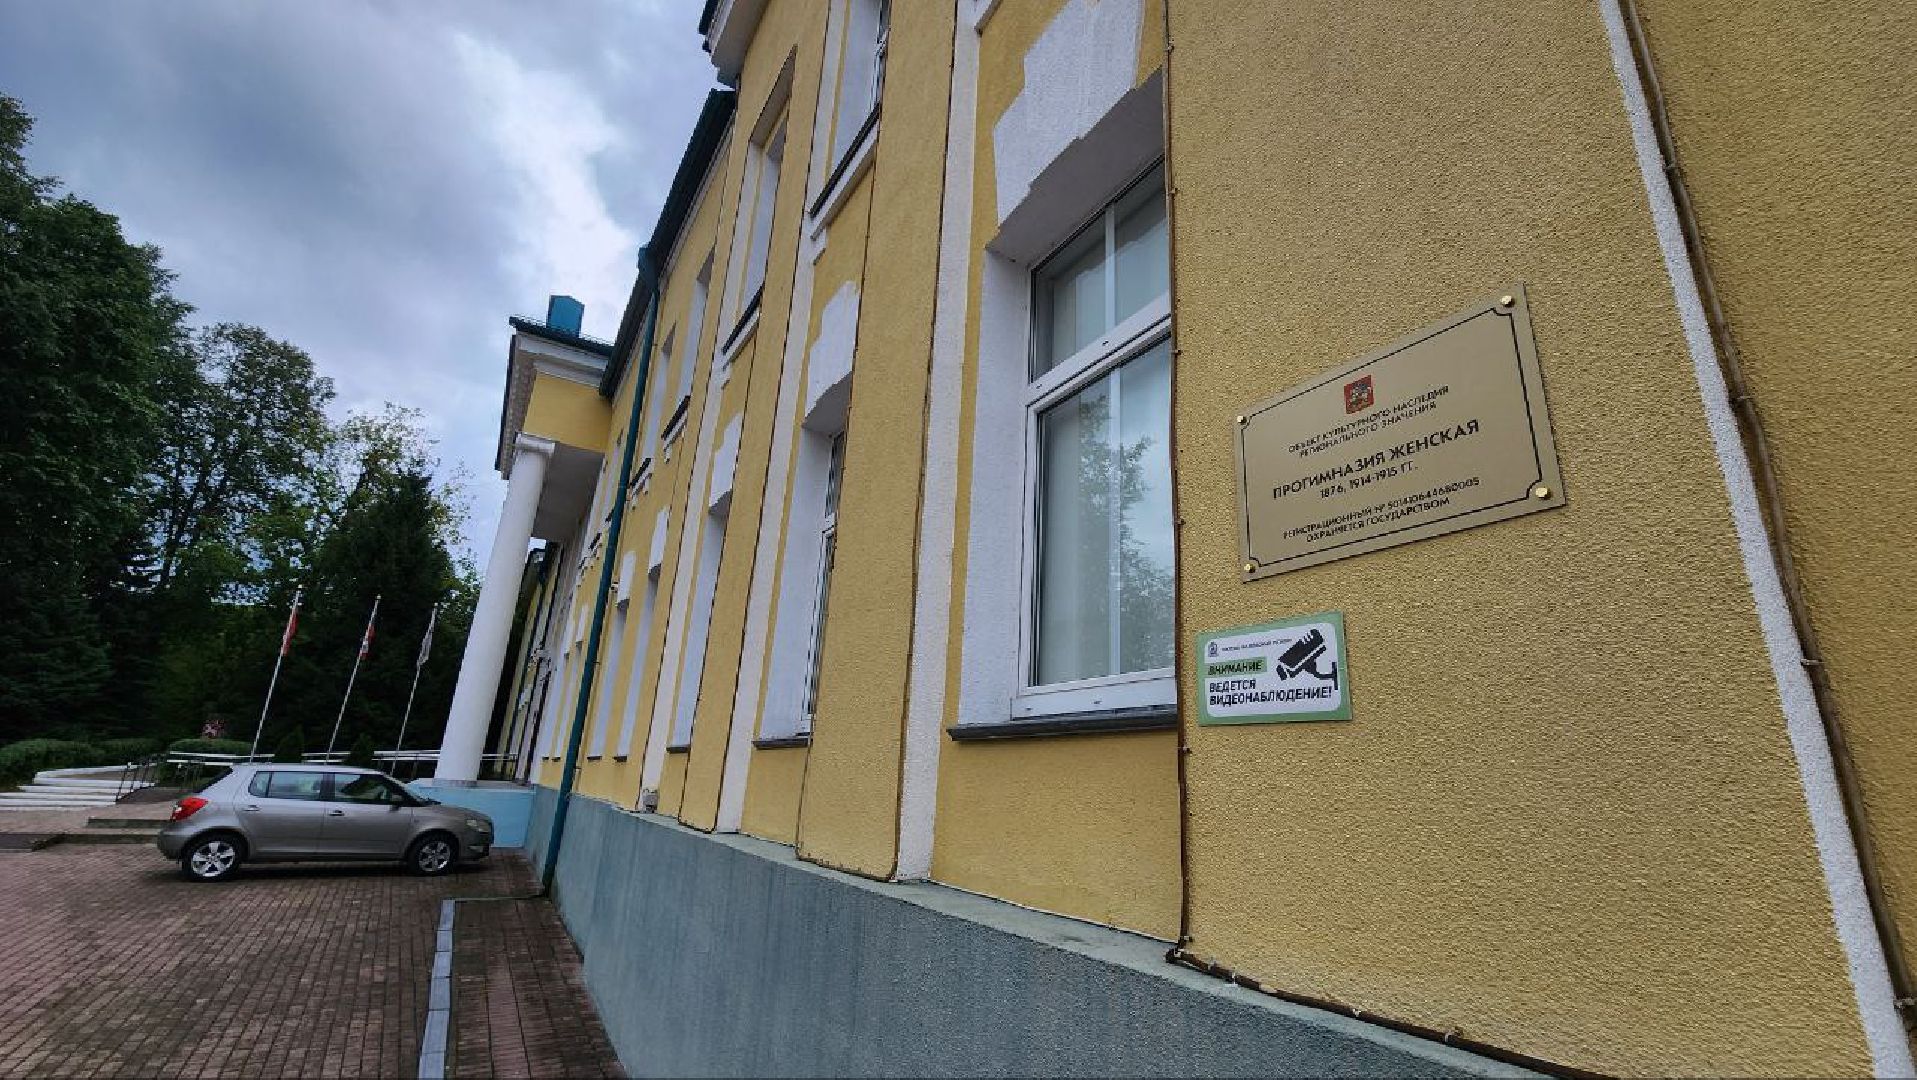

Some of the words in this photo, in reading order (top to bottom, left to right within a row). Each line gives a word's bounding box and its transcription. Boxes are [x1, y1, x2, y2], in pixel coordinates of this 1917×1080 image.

[1289, 434, 1320, 453] ОБЪЕКТ
[1323, 408, 1391, 440] КУЛЬТУРНОГО
[1394, 386, 1448, 413] НАСЛЕДИЯ
[1300, 423, 1378, 458] РЕГИОНАЛЬНОГО
[1382, 401, 1436, 428] ЗНАЧЕНИЯ
[1273, 452, 1386, 499] ПРОГИМНАЗИЯ
[1389, 419, 1479, 461] ЖЕНСКАЯ
[1350, 467, 1398, 489] 1914-1915
[1401, 461, 1418, 474] ГГ.
[1283, 506, 1371, 539] РЕГИСТРАЦИОННЫЙ
[1307, 520, 1364, 542] ОХРАНЯЕТСЯ
[1367, 497, 1450, 526] ГОСУДАРСТВОМ
[1208, 660, 1262, 676] ВНИМАНИЕ
[1209, 679, 1257, 693] ВЕДЕТСЯ
[1209, 686, 1332, 707] ВИДЕОНАБЛЮДЕНИЕ!
